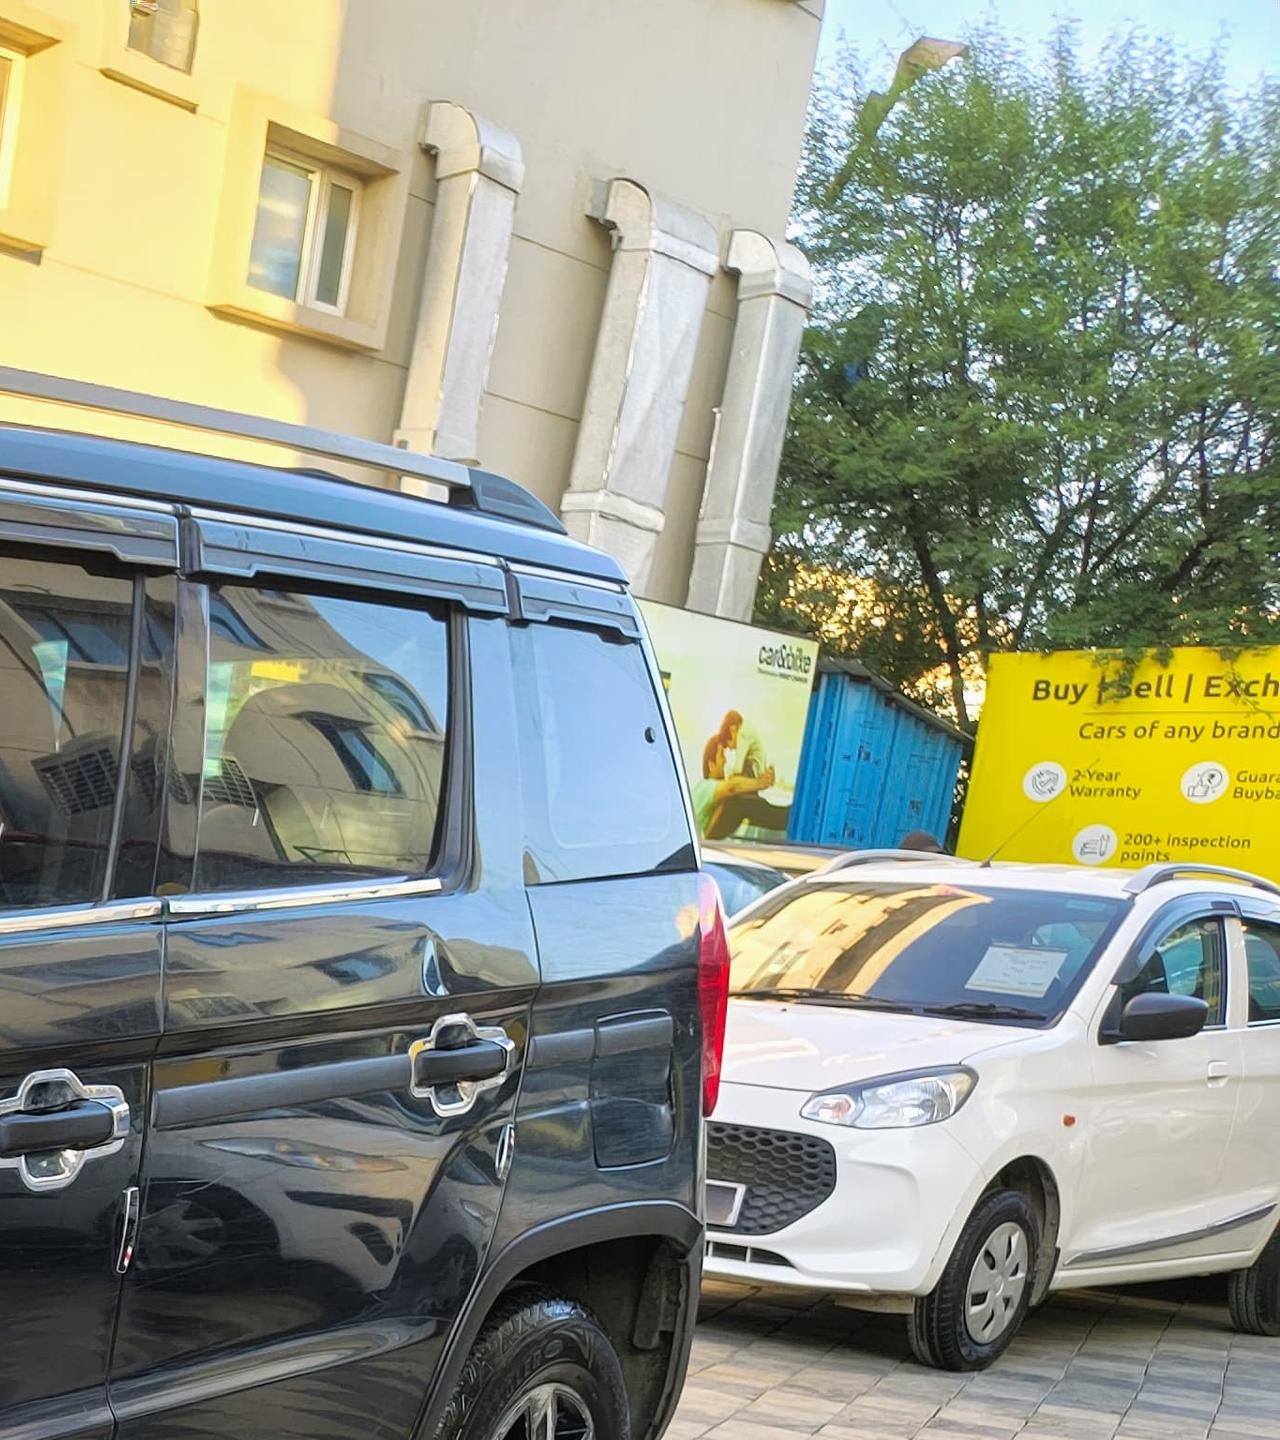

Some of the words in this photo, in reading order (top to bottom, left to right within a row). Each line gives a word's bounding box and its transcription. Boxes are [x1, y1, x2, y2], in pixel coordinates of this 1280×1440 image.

[1032, 679, 1088, 704] Buy
[1079, 723, 1126, 740] Cars
[1133, 720, 1160, 739] of
[1164, 724, 1205, 743] any
[1072, 769, 1121, 783] 2-Year
[1070, 785, 1141, 800] Warranty
[1124, 833, 1161, 847] 200+
[1167, 833, 1251, 850] inspection
[1120, 850, 1171, 863] points
